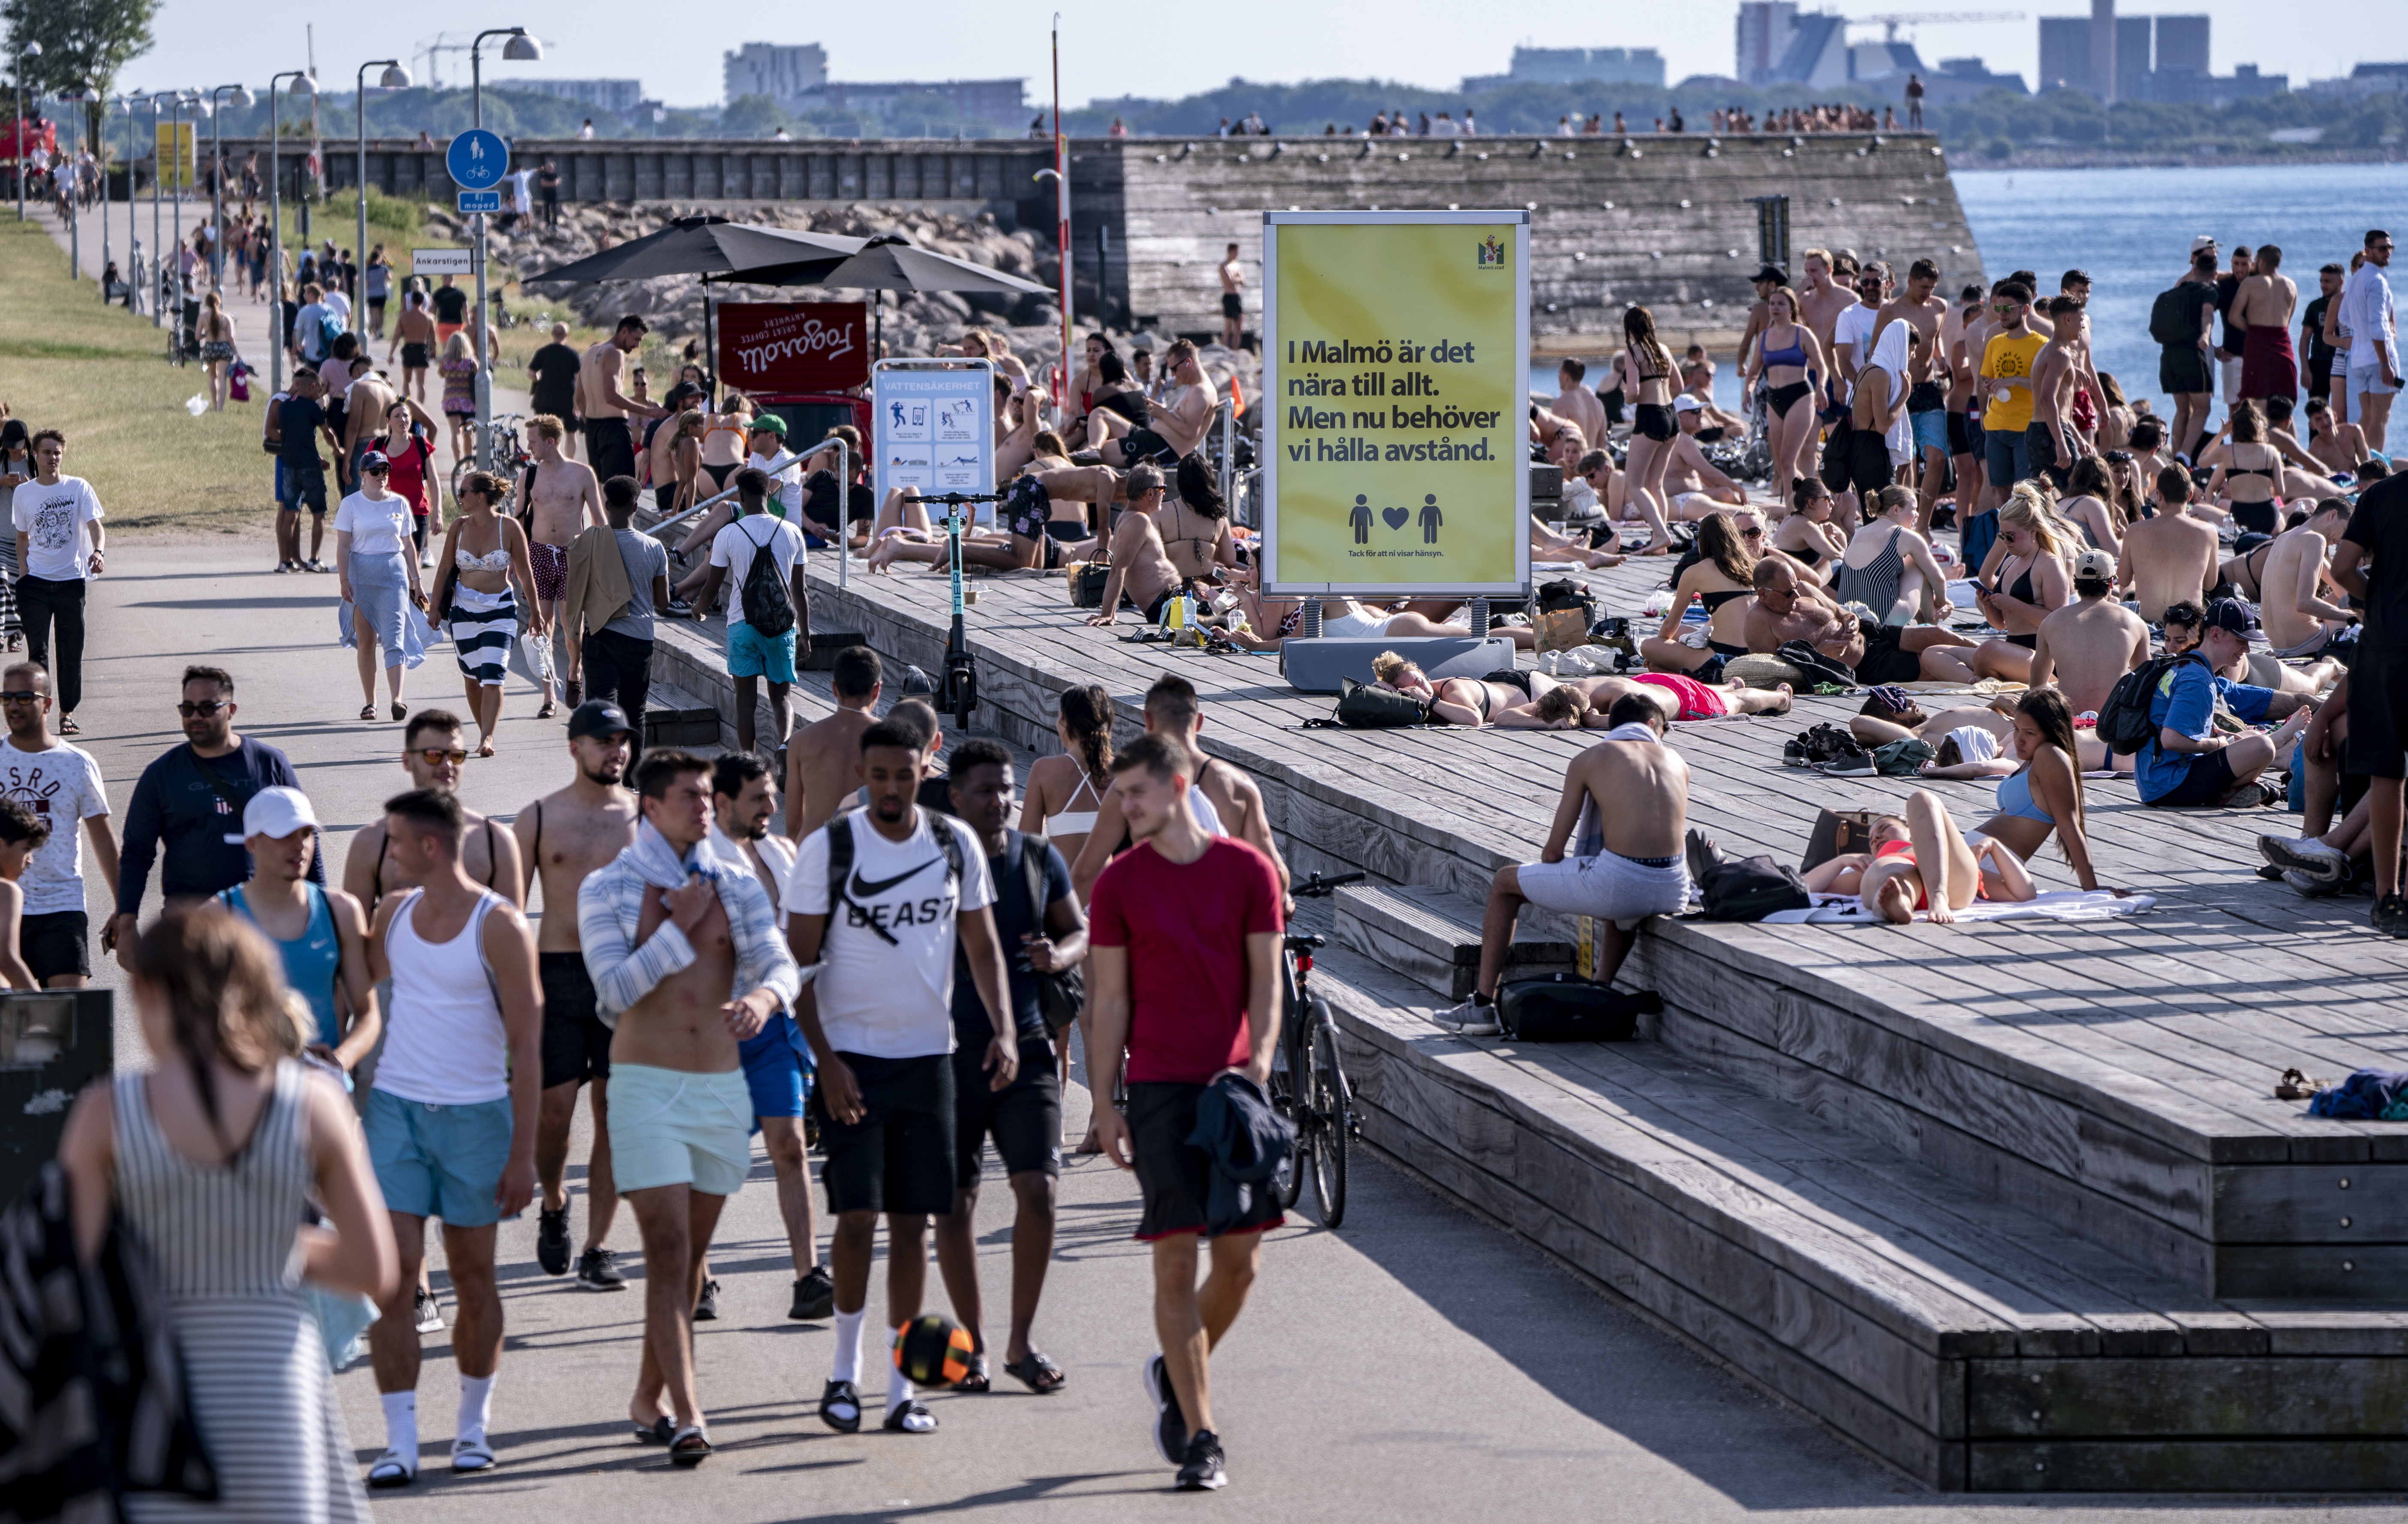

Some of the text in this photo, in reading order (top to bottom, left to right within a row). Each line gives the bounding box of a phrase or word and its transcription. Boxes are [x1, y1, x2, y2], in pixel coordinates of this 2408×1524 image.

[475, 193, 483, 202] Ej
[464, 202, 495, 210] moped
[415, 258, 468, 266] Ankarstigen
[763, 312, 806, 328] ANYWHERE
[740, 325, 796, 343] GREAT COFFEE
[1289, 339, 1475, 364] I Malmö är det
[884, 381, 980, 391] VATTENSÄKERHET
[1288, 372, 1439, 397] nära till allt.
[1288, 404, 1500, 429] Men nu behöver
[1288, 436, 1495, 462] vi hålla avstånd.
[1415, 549, 1444, 558] hänsyn.
[2086, 555, 2094, 563] 3
[953, 572, 962, 611] TIER
